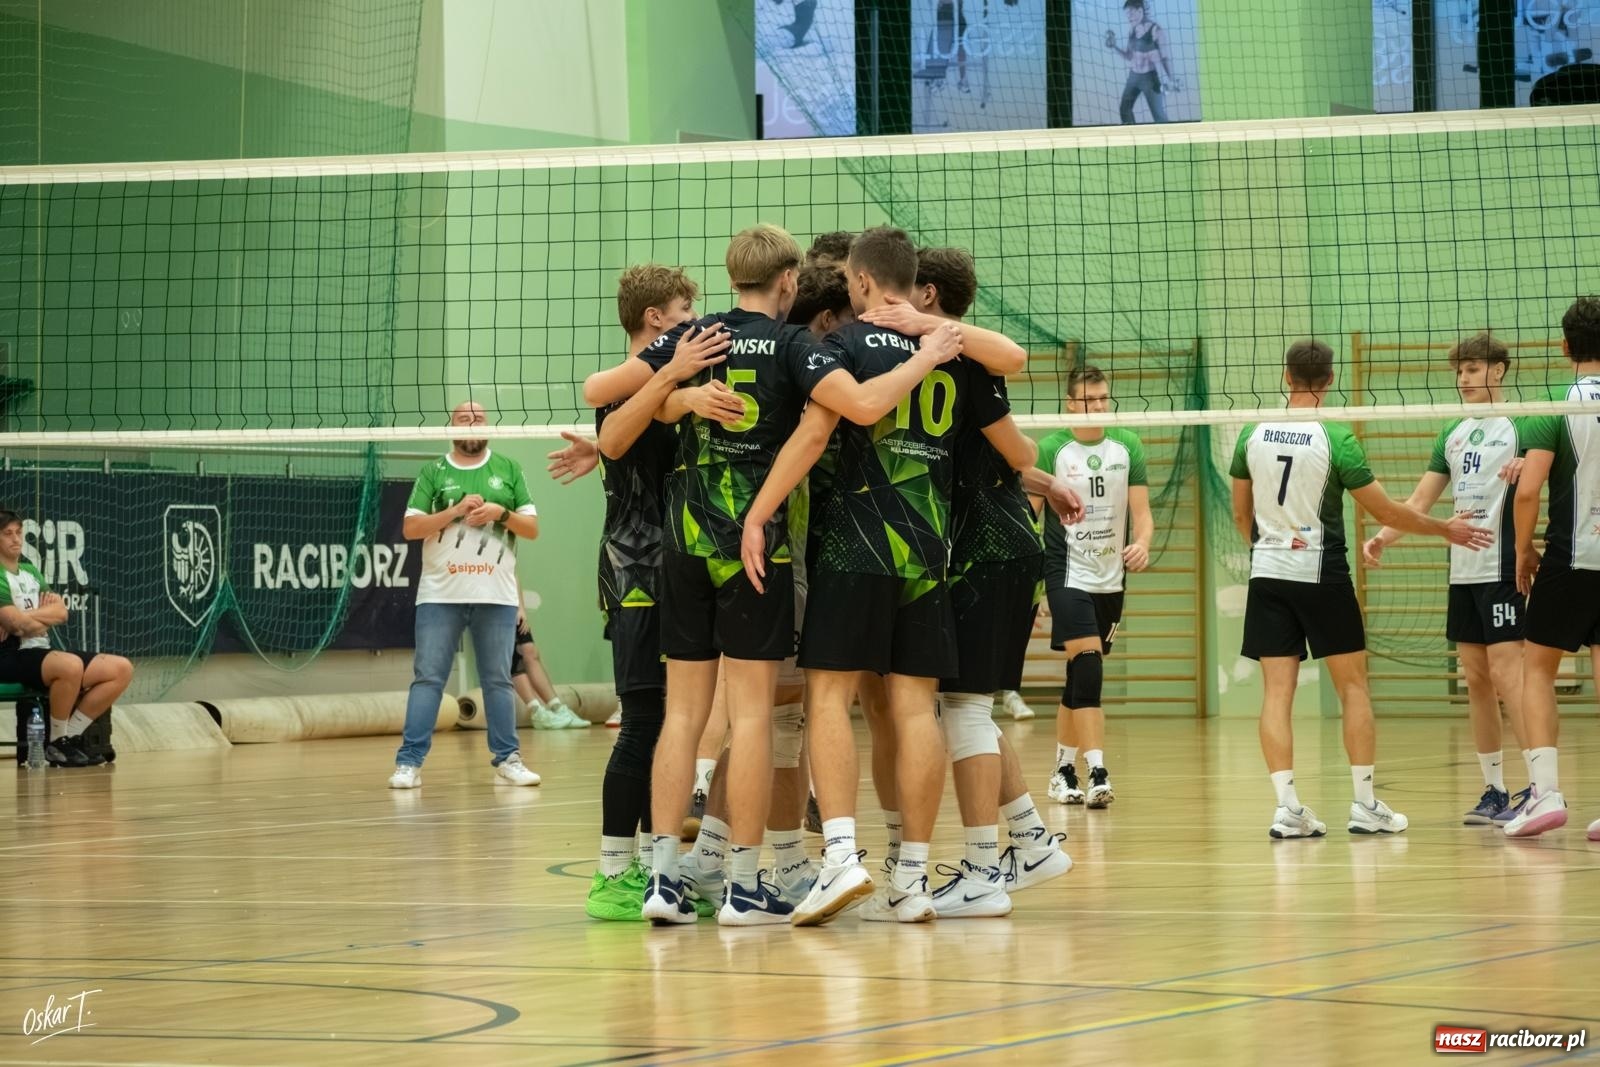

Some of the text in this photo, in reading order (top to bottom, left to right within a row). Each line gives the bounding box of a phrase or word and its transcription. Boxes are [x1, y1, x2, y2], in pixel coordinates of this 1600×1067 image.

[728, 338, 776, 355] WSKI
[722, 367, 760, 433] 5
[896, 369, 957, 437] 10
[1263, 429, 1313, 446] BŁASZCZOK
[1463, 451, 1481, 474] 54
[1088, 476, 1105, 498] 16
[1277, 455, 1293, 506] 7
[458, 563, 494, 575] sipply
[1492, 603, 1516, 628] 54
